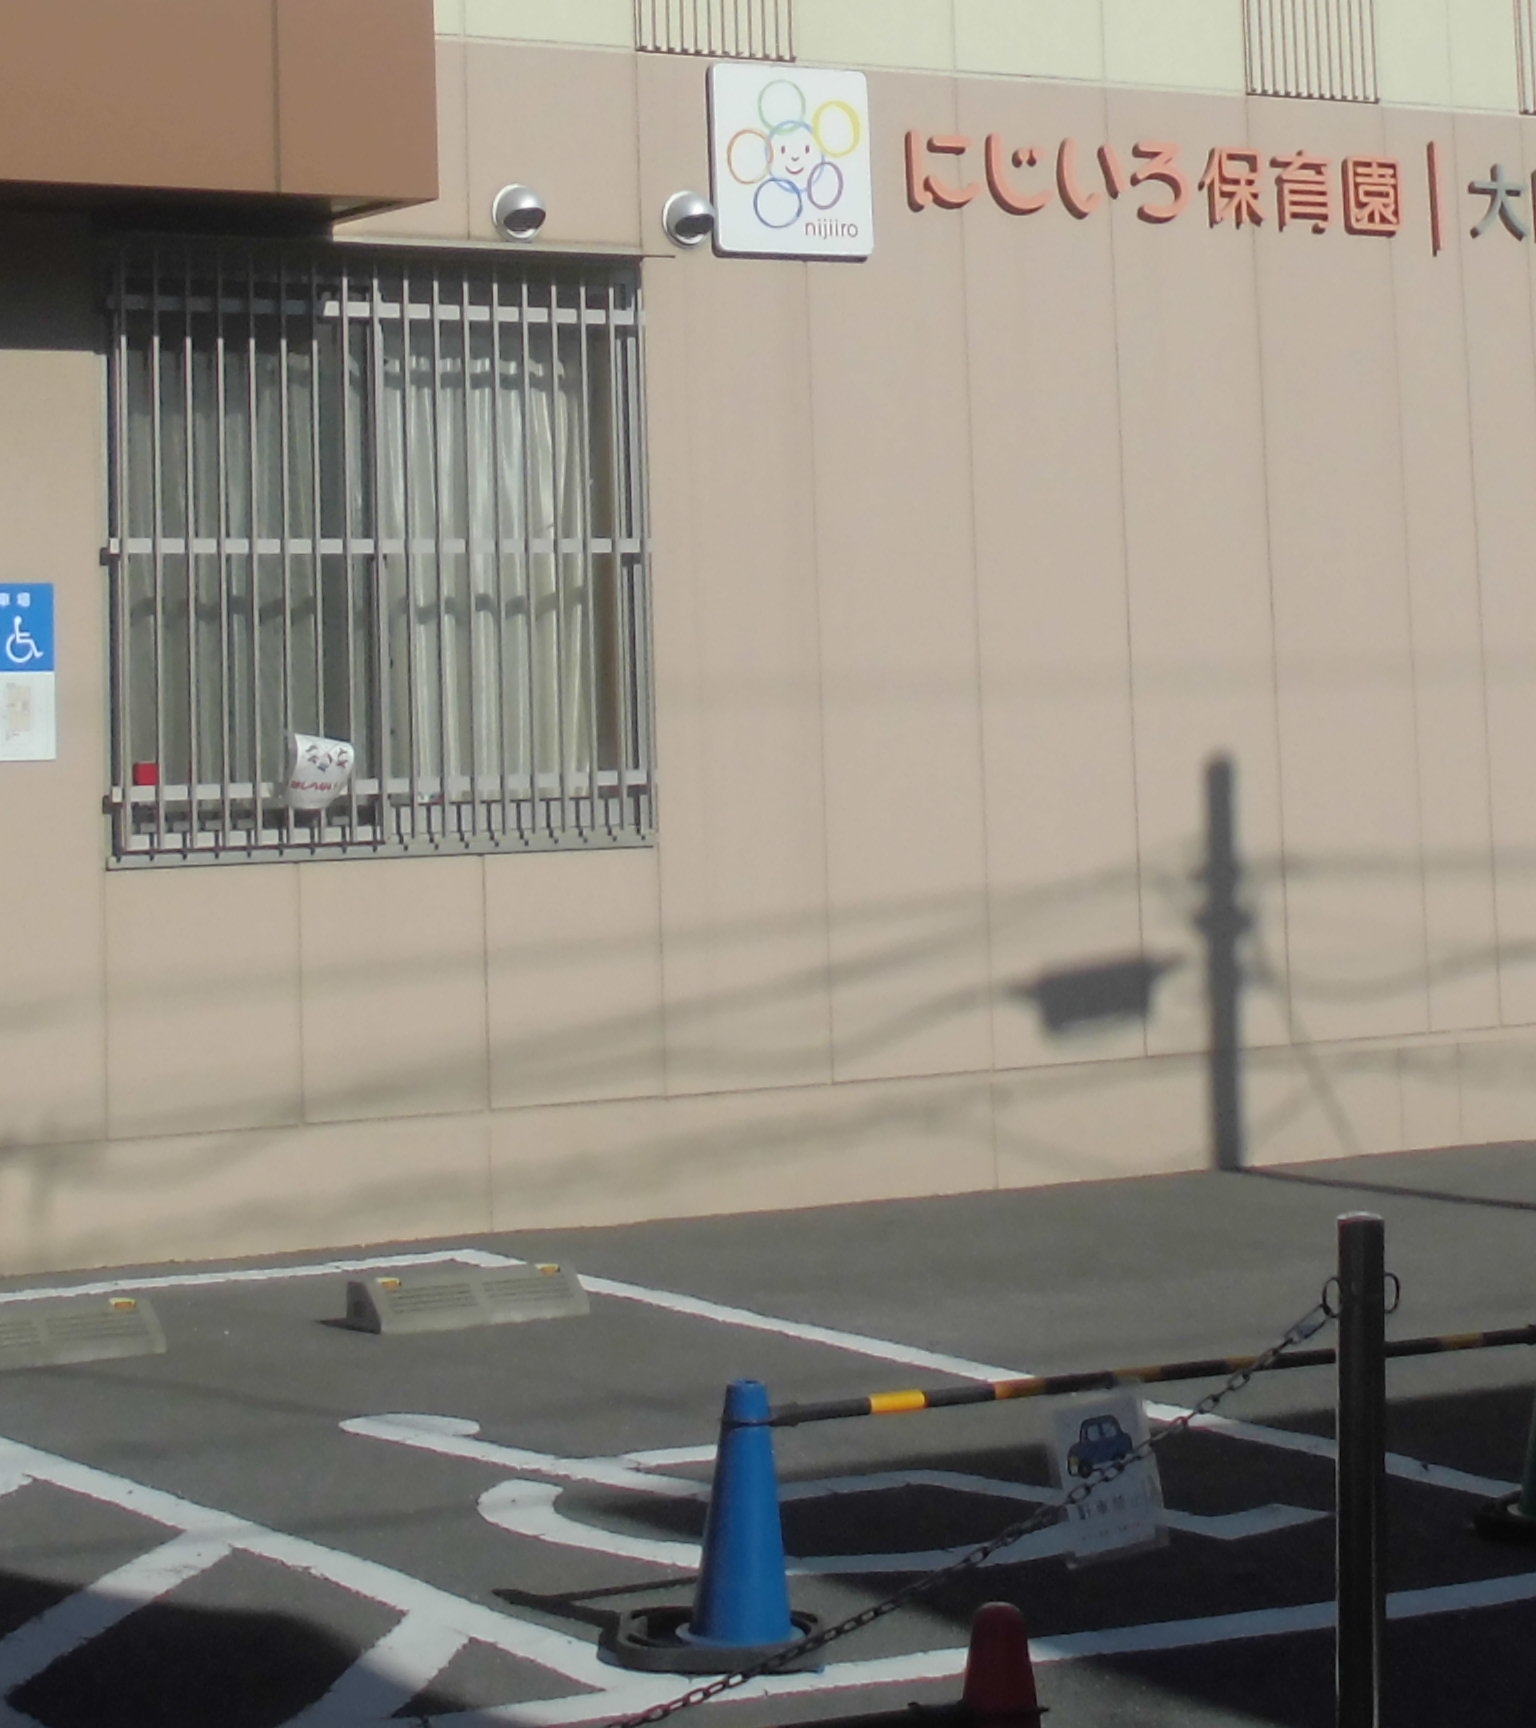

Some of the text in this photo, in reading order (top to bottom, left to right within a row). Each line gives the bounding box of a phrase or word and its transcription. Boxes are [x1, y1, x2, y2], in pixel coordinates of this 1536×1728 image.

[904, 130, 1401, 238] にじいろ保育園
[804, 218, 858, 240] nijiiro
